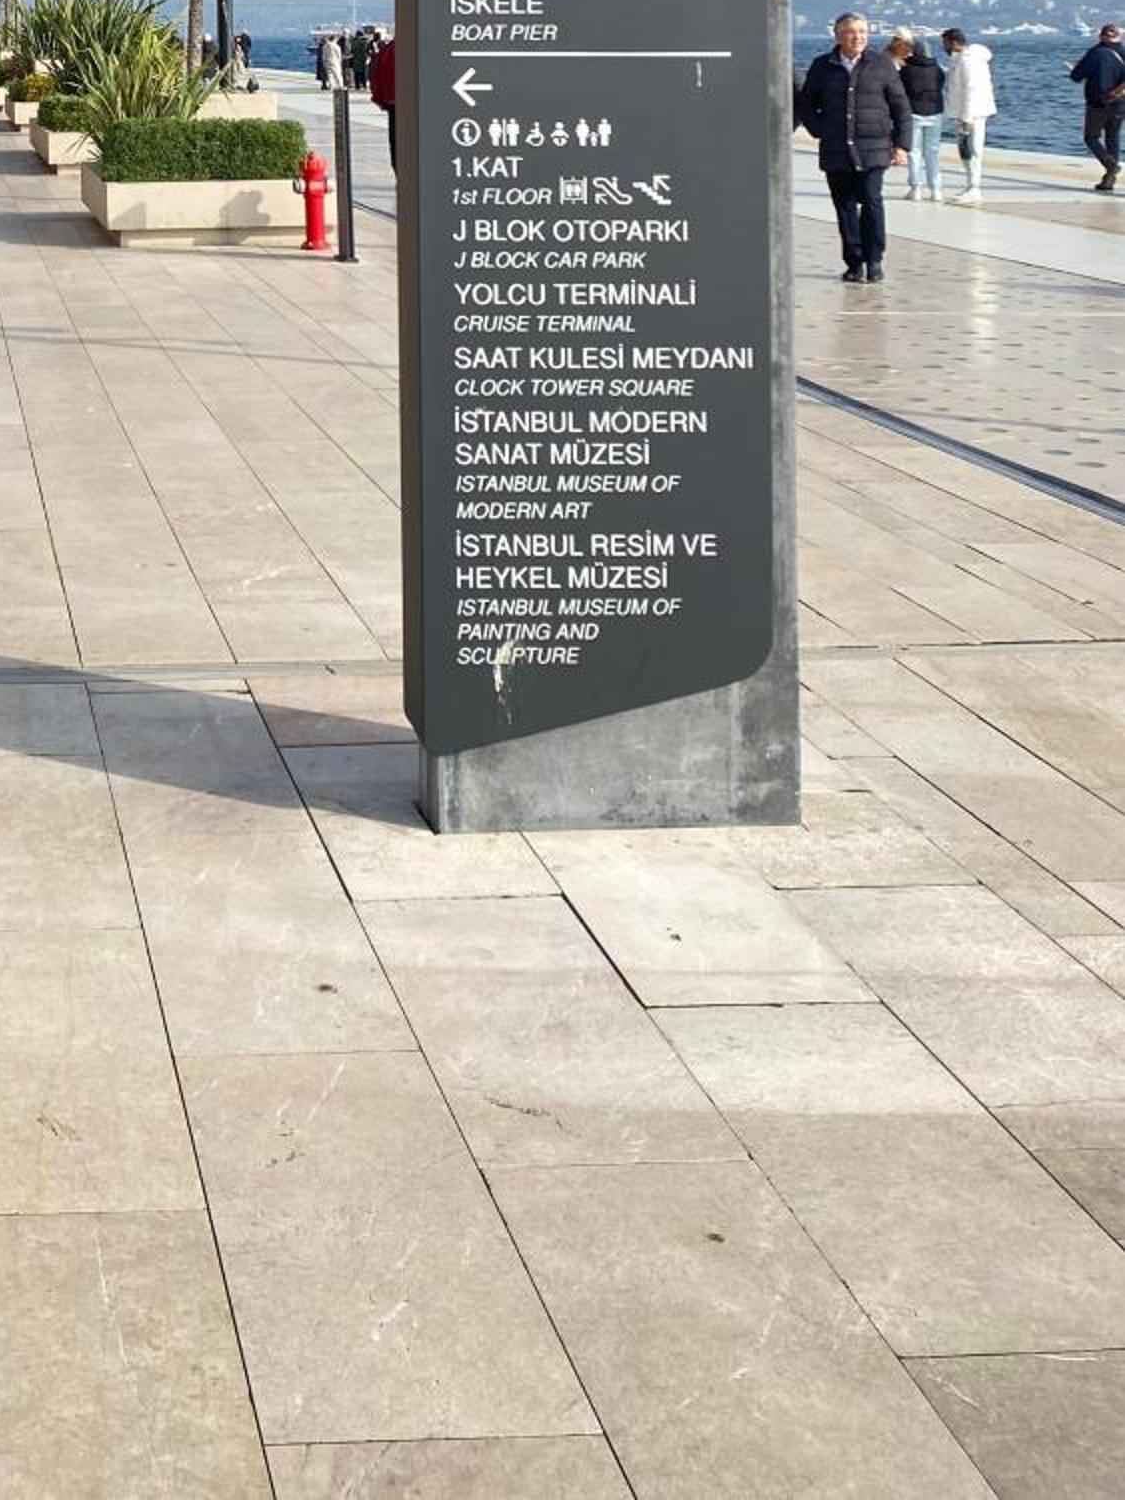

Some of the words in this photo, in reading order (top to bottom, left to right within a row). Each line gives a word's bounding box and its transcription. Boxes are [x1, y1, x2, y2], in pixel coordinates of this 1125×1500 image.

[450, 23, 508, 42] BOAT
[509, 23, 559, 42] PIER
[451, 155, 524, 179] 1.KAT
[452, 187, 479, 206] 1st
[481, 187, 554, 206] FLOOR
[452, 219, 467, 242] J
[474, 219, 546, 243] BLOK
[552, 219, 689, 243] OTOPARKI
[453, 251, 468, 269] J
[470, 250, 541, 269] BLOCK
[543, 251, 588, 269] CAR
[591, 251, 648, 269] PARK
[453, 282, 547, 307] YOLCU
[552, 278, 697, 306] TERMİNALİ
[453, 314, 532, 333] CRUISE
[535, 314, 636, 333] TERMINAL
[454, 346, 524, 370] SAAT
[529, 342, 625, 370] KULESİ
[632, 346, 754, 370] MEYDANI
[454, 378, 526, 397] CLOCK
[530, 378, 605, 397] TOWER
[607, 378, 695, 397] SQUARE
[454, 405, 584, 434] İSTANBUL
[588, 410, 708, 434] MODERN
[454, 441, 544, 466] SANAT
[549, 437, 650, 467] MÜZESİ
[455, 474, 552, 493] ISTANBUL
[556, 474, 648, 493] MUSEUM
[650, 474, 682, 493] OF
[455, 501, 548, 520] MODERN
[549, 501, 593, 520] ART
[455, 529, 584, 558] İSTANBUL
[590, 529, 675, 558] RESİM
[680, 533, 718, 557] VE
[456, 565, 562, 589] HEYKEL
[567, 561, 668, 590] MÜZESİ
[456, 597, 554, 617] ISTANBUL
[557, 597, 649, 617] MUSEUM
[652, 597, 683, 616] OF
[456, 622, 552, 641] PAINTING
[554, 622, 600, 641] AND
[456, 646, 581, 665] SCUPTURE
